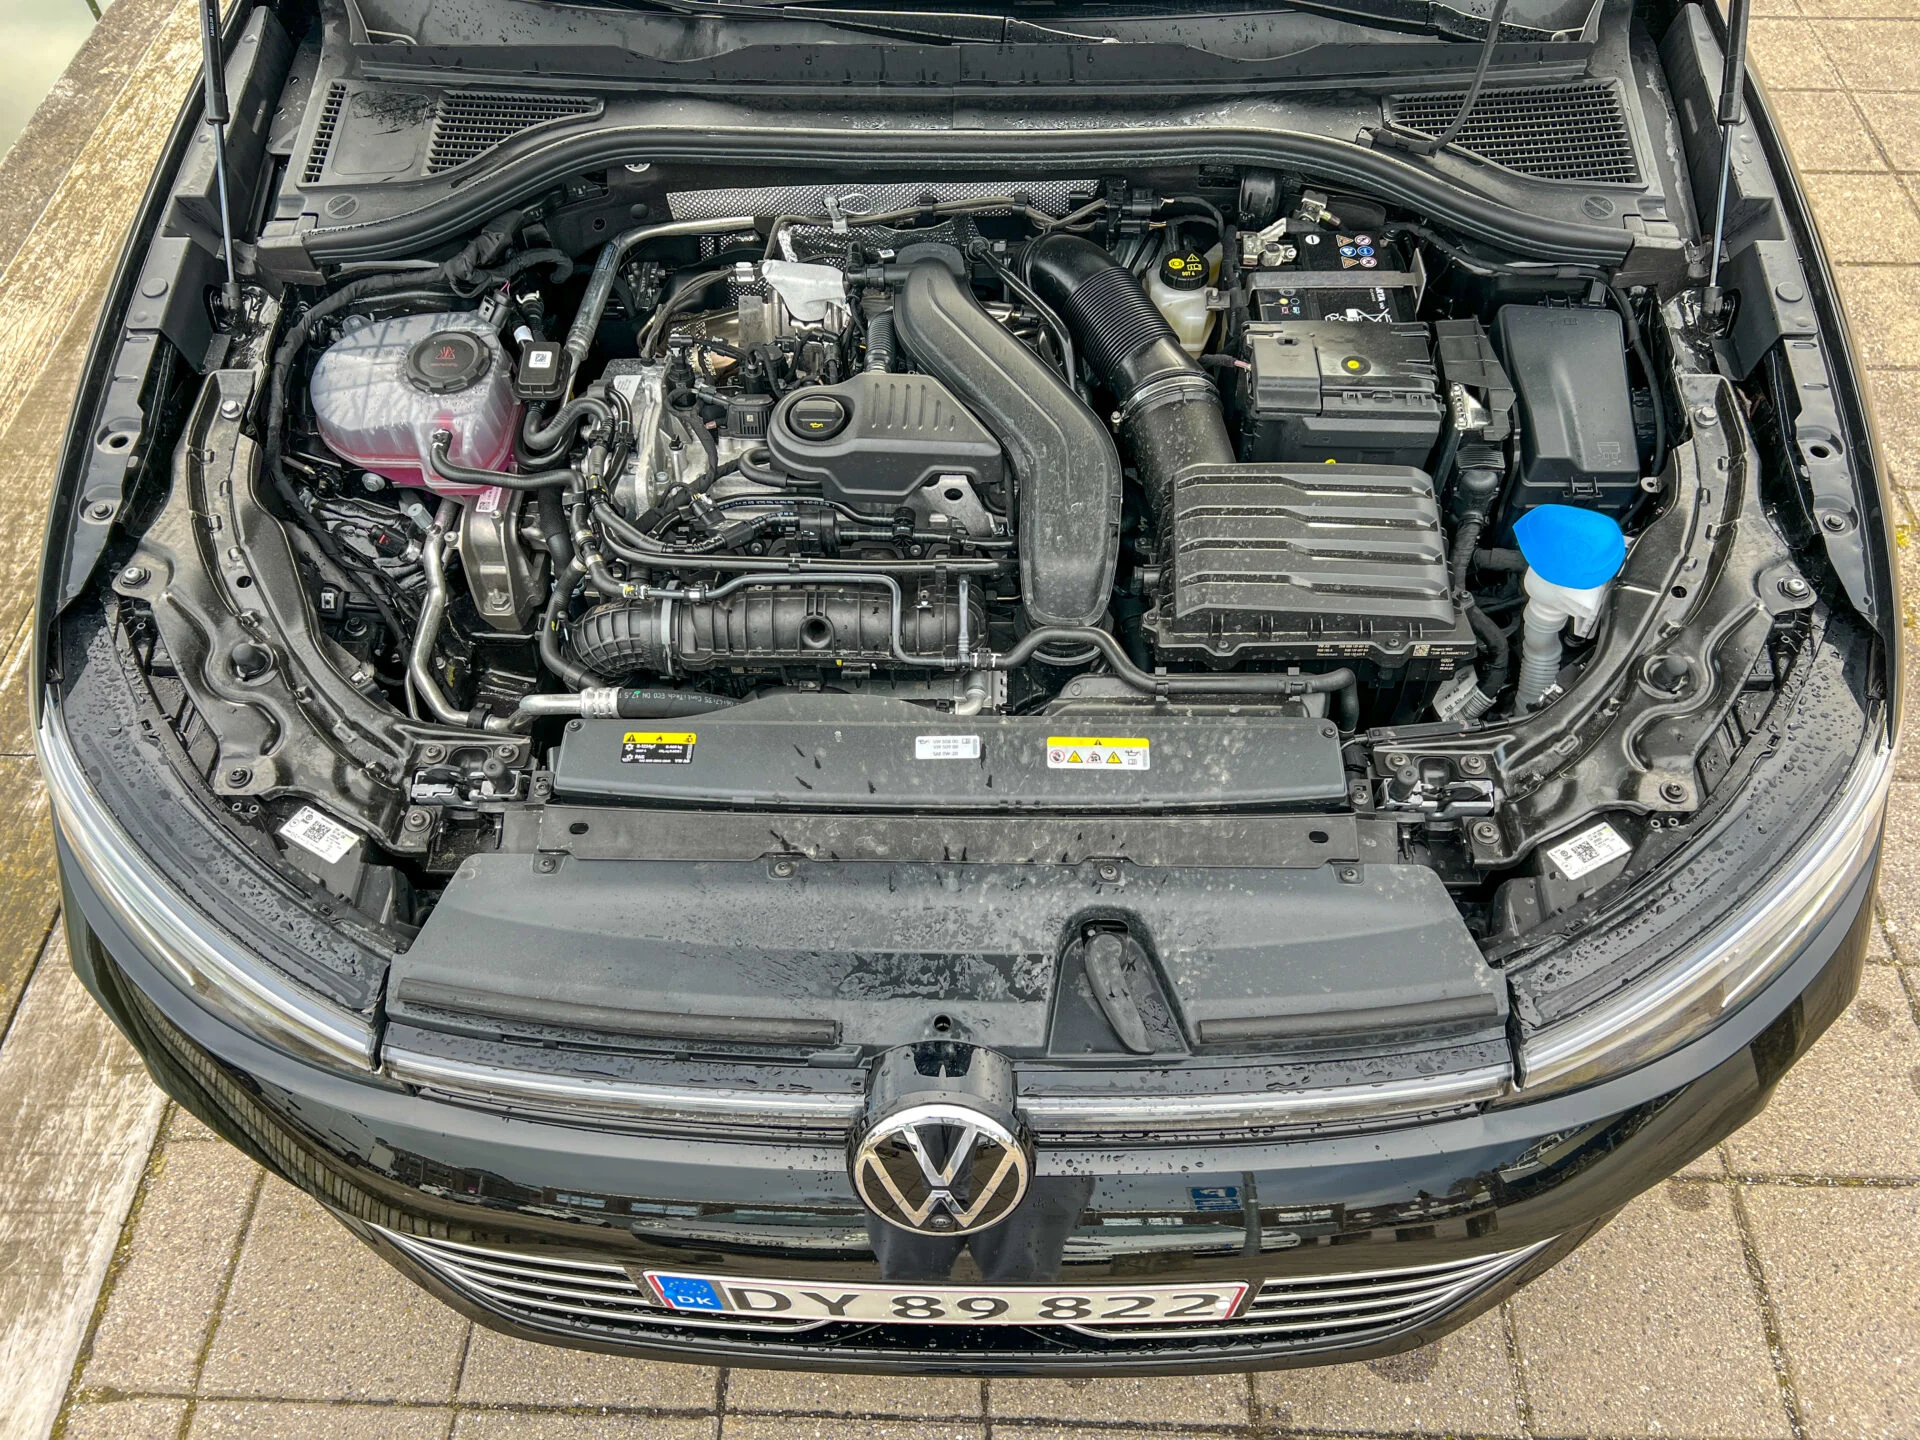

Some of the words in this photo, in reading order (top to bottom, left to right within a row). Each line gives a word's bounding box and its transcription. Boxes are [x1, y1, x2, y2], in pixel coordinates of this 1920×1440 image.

[676, 1294, 714, 1306] DK
[727, 1287, 861, 1316] DY
[890, 1295, 1010, 1319] 89
[1038, 1293, 1221, 1320] 822
